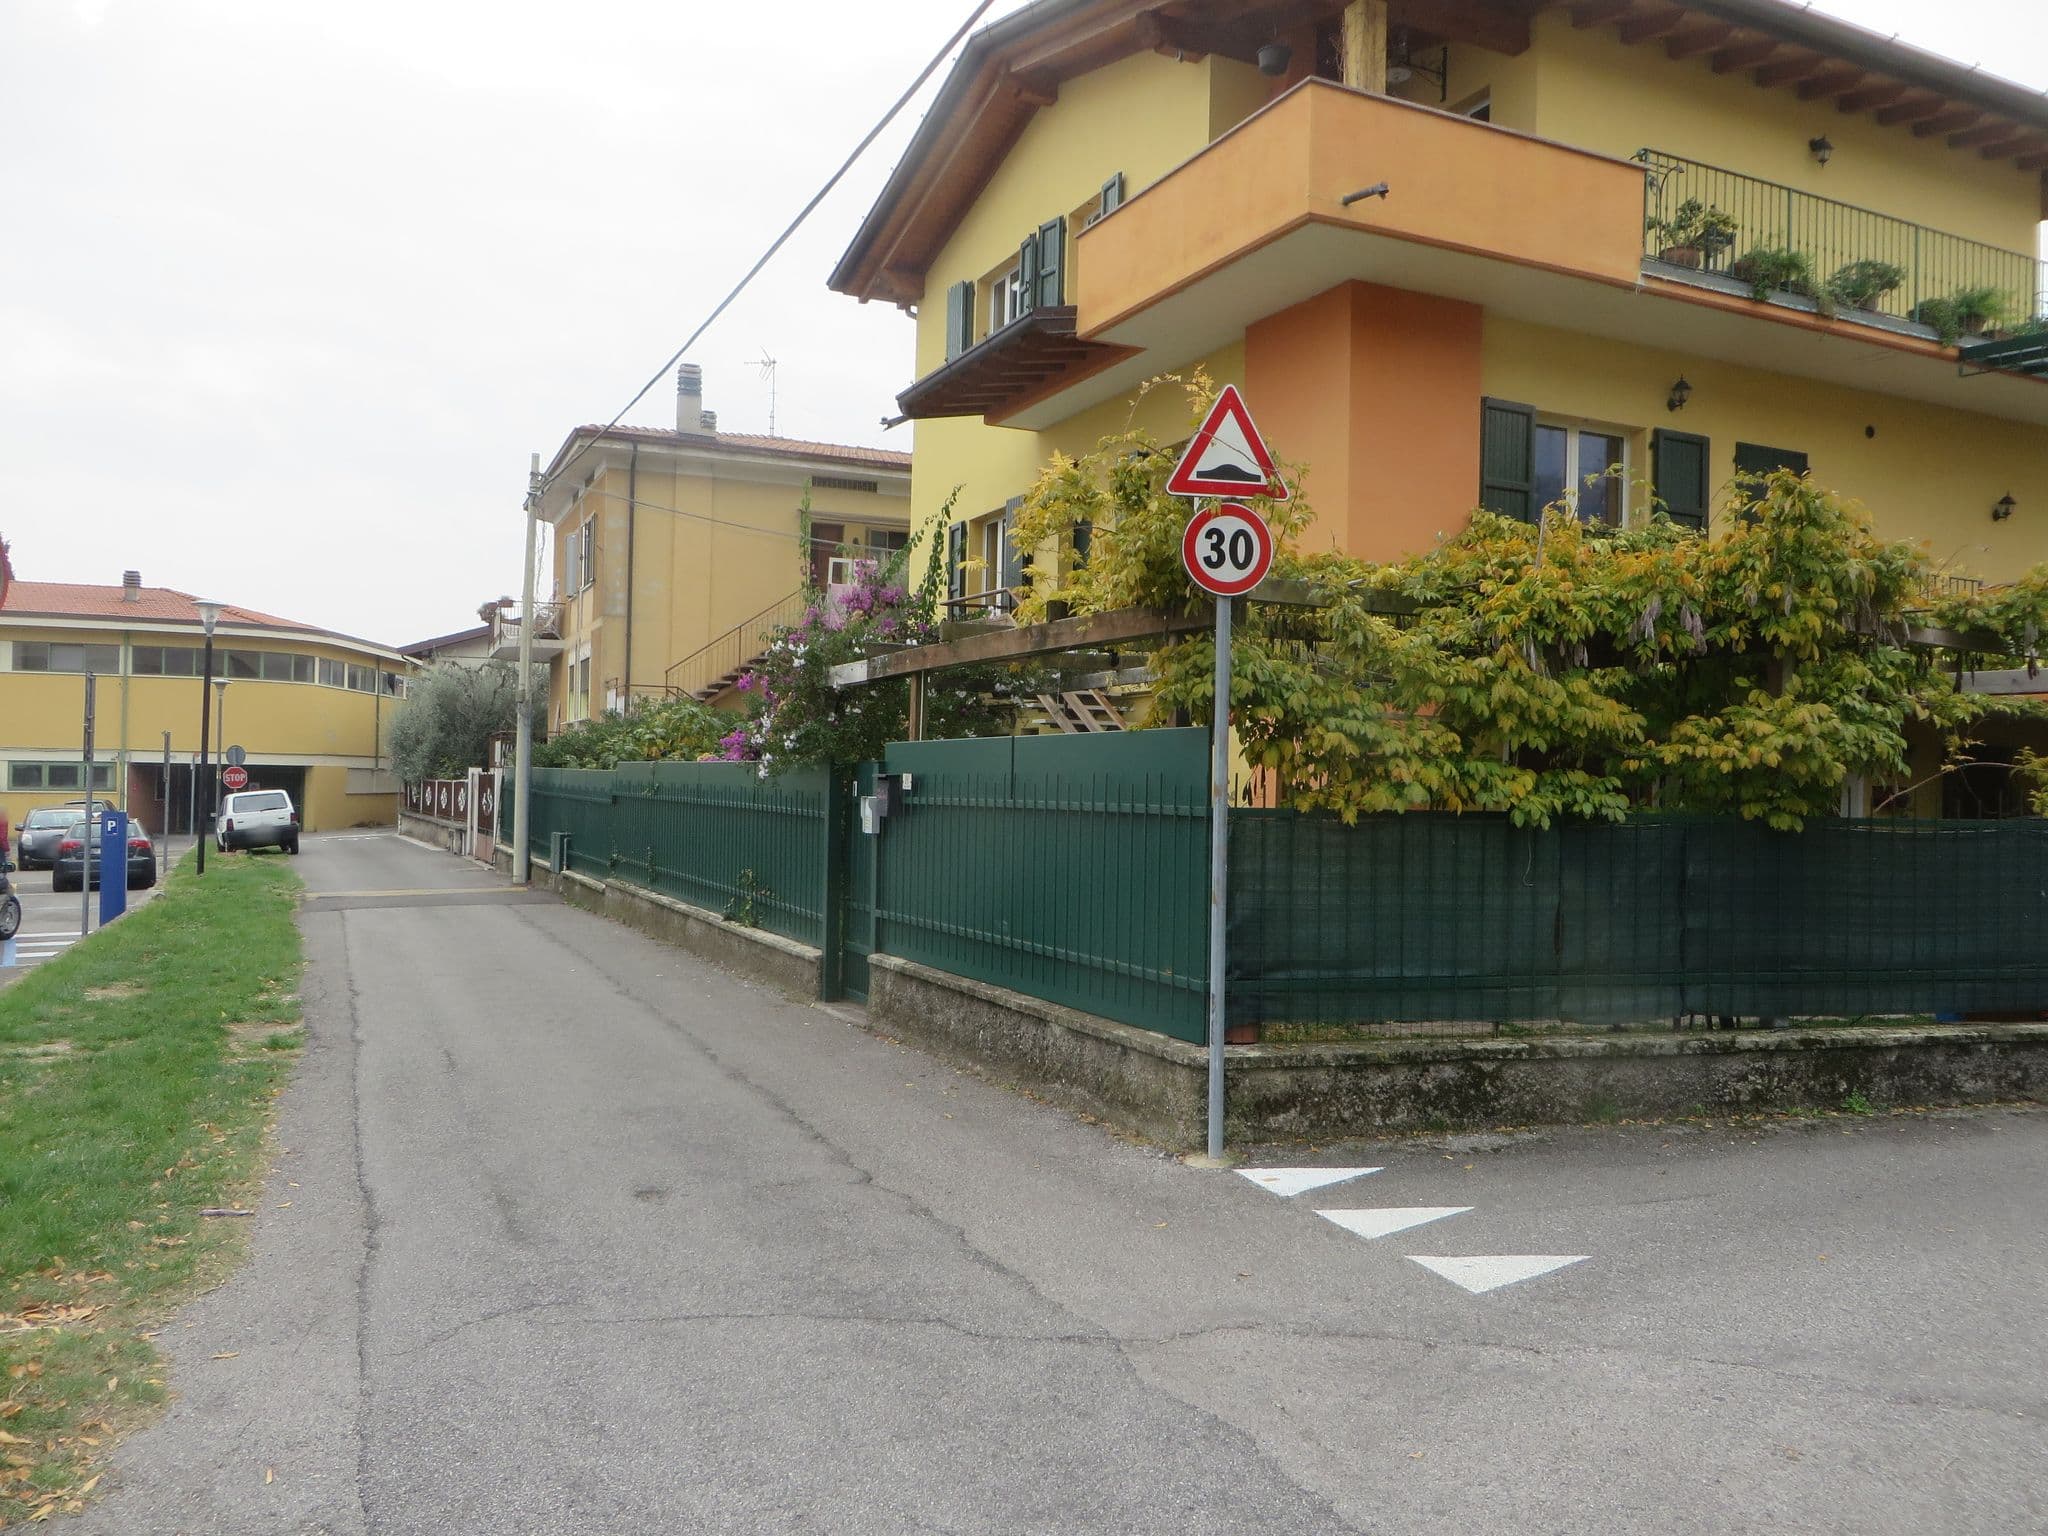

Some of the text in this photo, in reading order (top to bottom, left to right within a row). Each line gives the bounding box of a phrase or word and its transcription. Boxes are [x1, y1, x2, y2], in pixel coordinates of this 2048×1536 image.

[1203, 528, 1254, 570] 30
[225, 773, 246, 782] STOP
[107, 820, 117, 831] P
